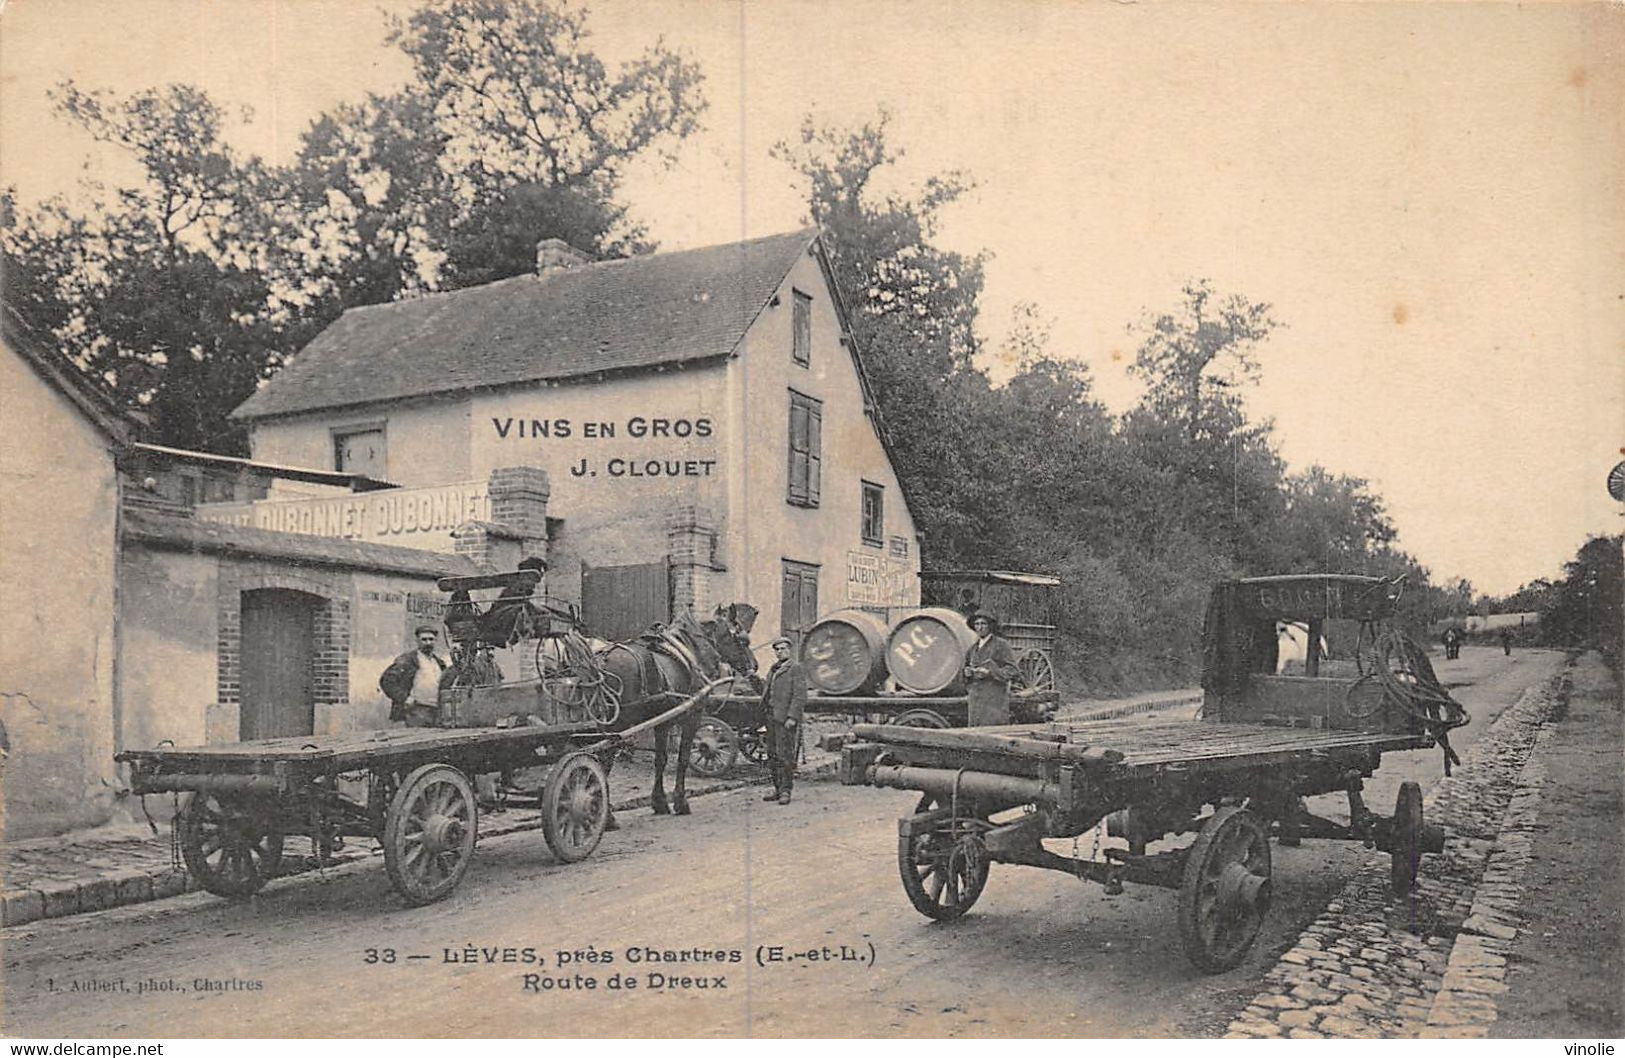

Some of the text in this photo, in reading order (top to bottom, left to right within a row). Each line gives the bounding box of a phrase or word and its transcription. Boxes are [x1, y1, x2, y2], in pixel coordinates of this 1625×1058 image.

[492, 417, 713, 438] VINS EN GROS
[571, 458, 716, 477] J. CLOUET
